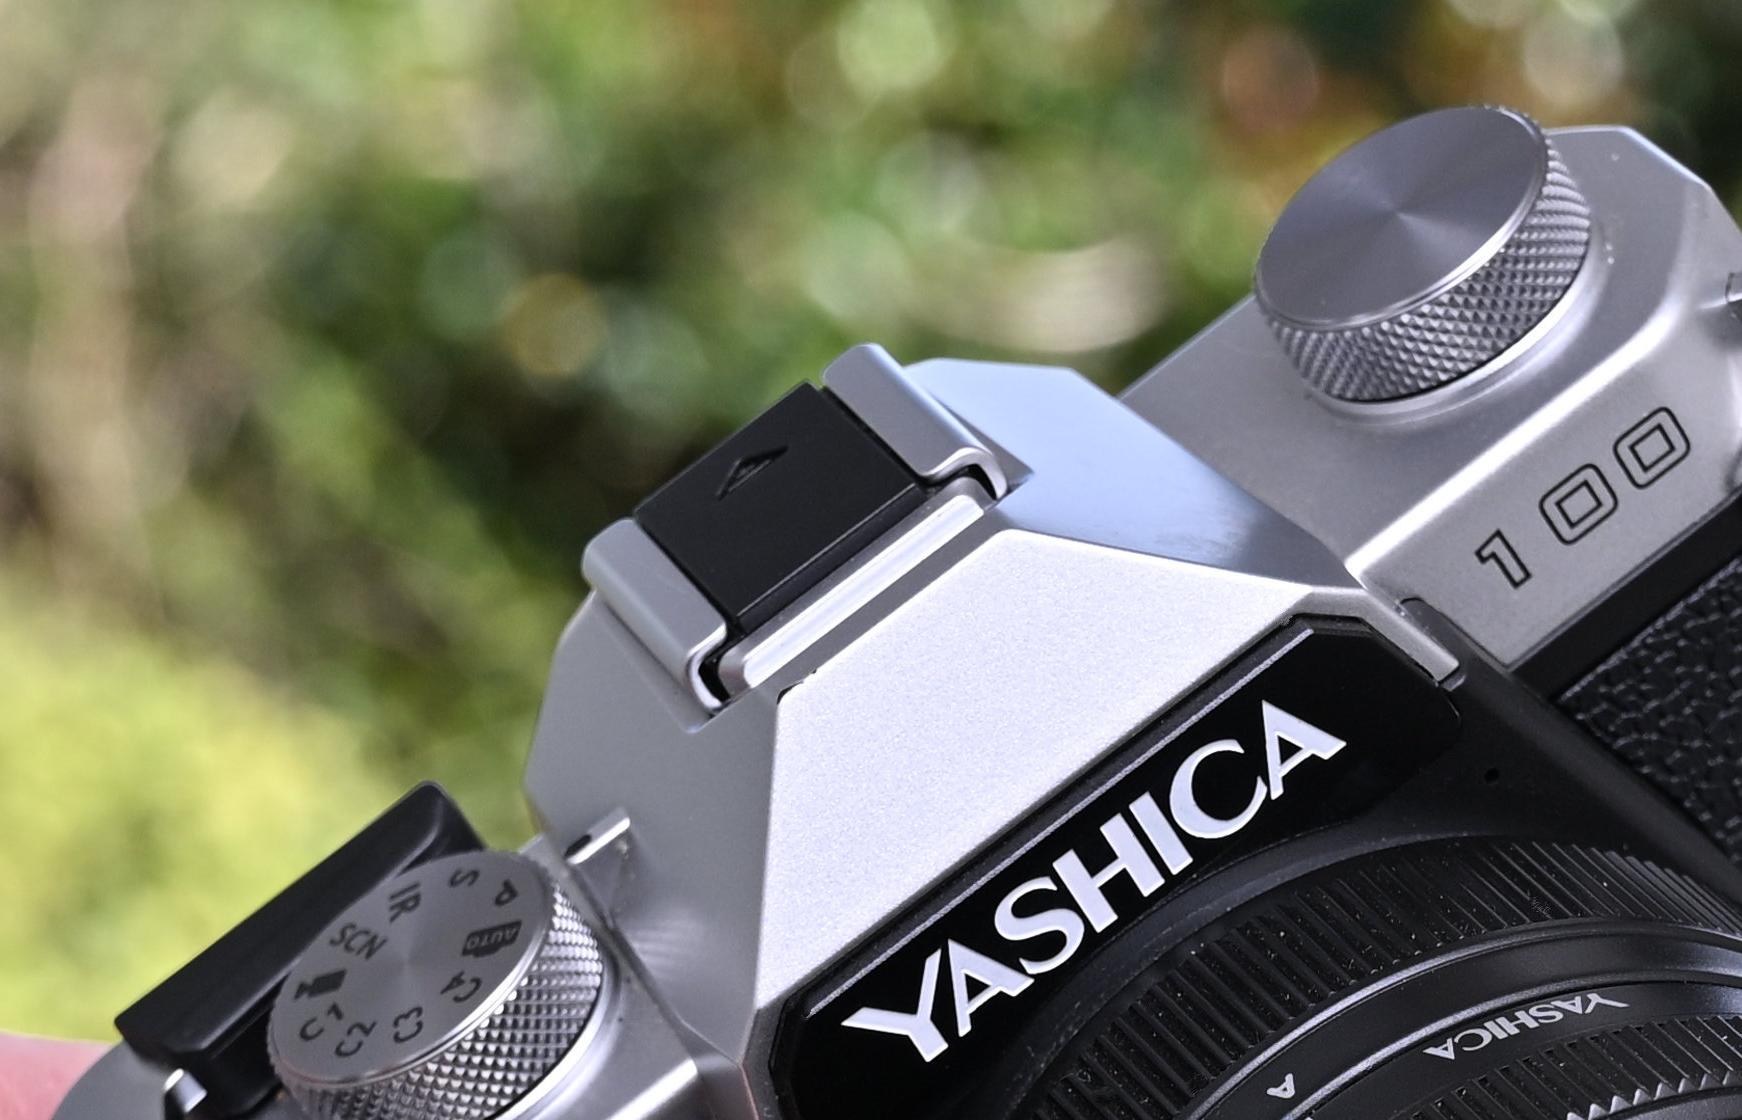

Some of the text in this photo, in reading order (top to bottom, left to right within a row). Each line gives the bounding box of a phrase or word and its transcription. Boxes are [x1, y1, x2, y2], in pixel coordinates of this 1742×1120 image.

[1475, 406, 1692, 588] 100
[447, 868, 481, 888] S
[494, 879, 519, 907] P
[840, 699, 1347, 1063] YASHICA
[389, 883, 422, 923] IR
[329, 922, 388, 960] SCN
[467, 926, 517, 950] AUTO
[440, 971, 482, 1003] C4
[299, 1003, 345, 1042] C1
[335, 1020, 378, 1058] C2
[393, 1006, 424, 1043] C3
[1424, 993, 1629, 1061] YASHICA
[1266, 1073, 1297, 1099] A
